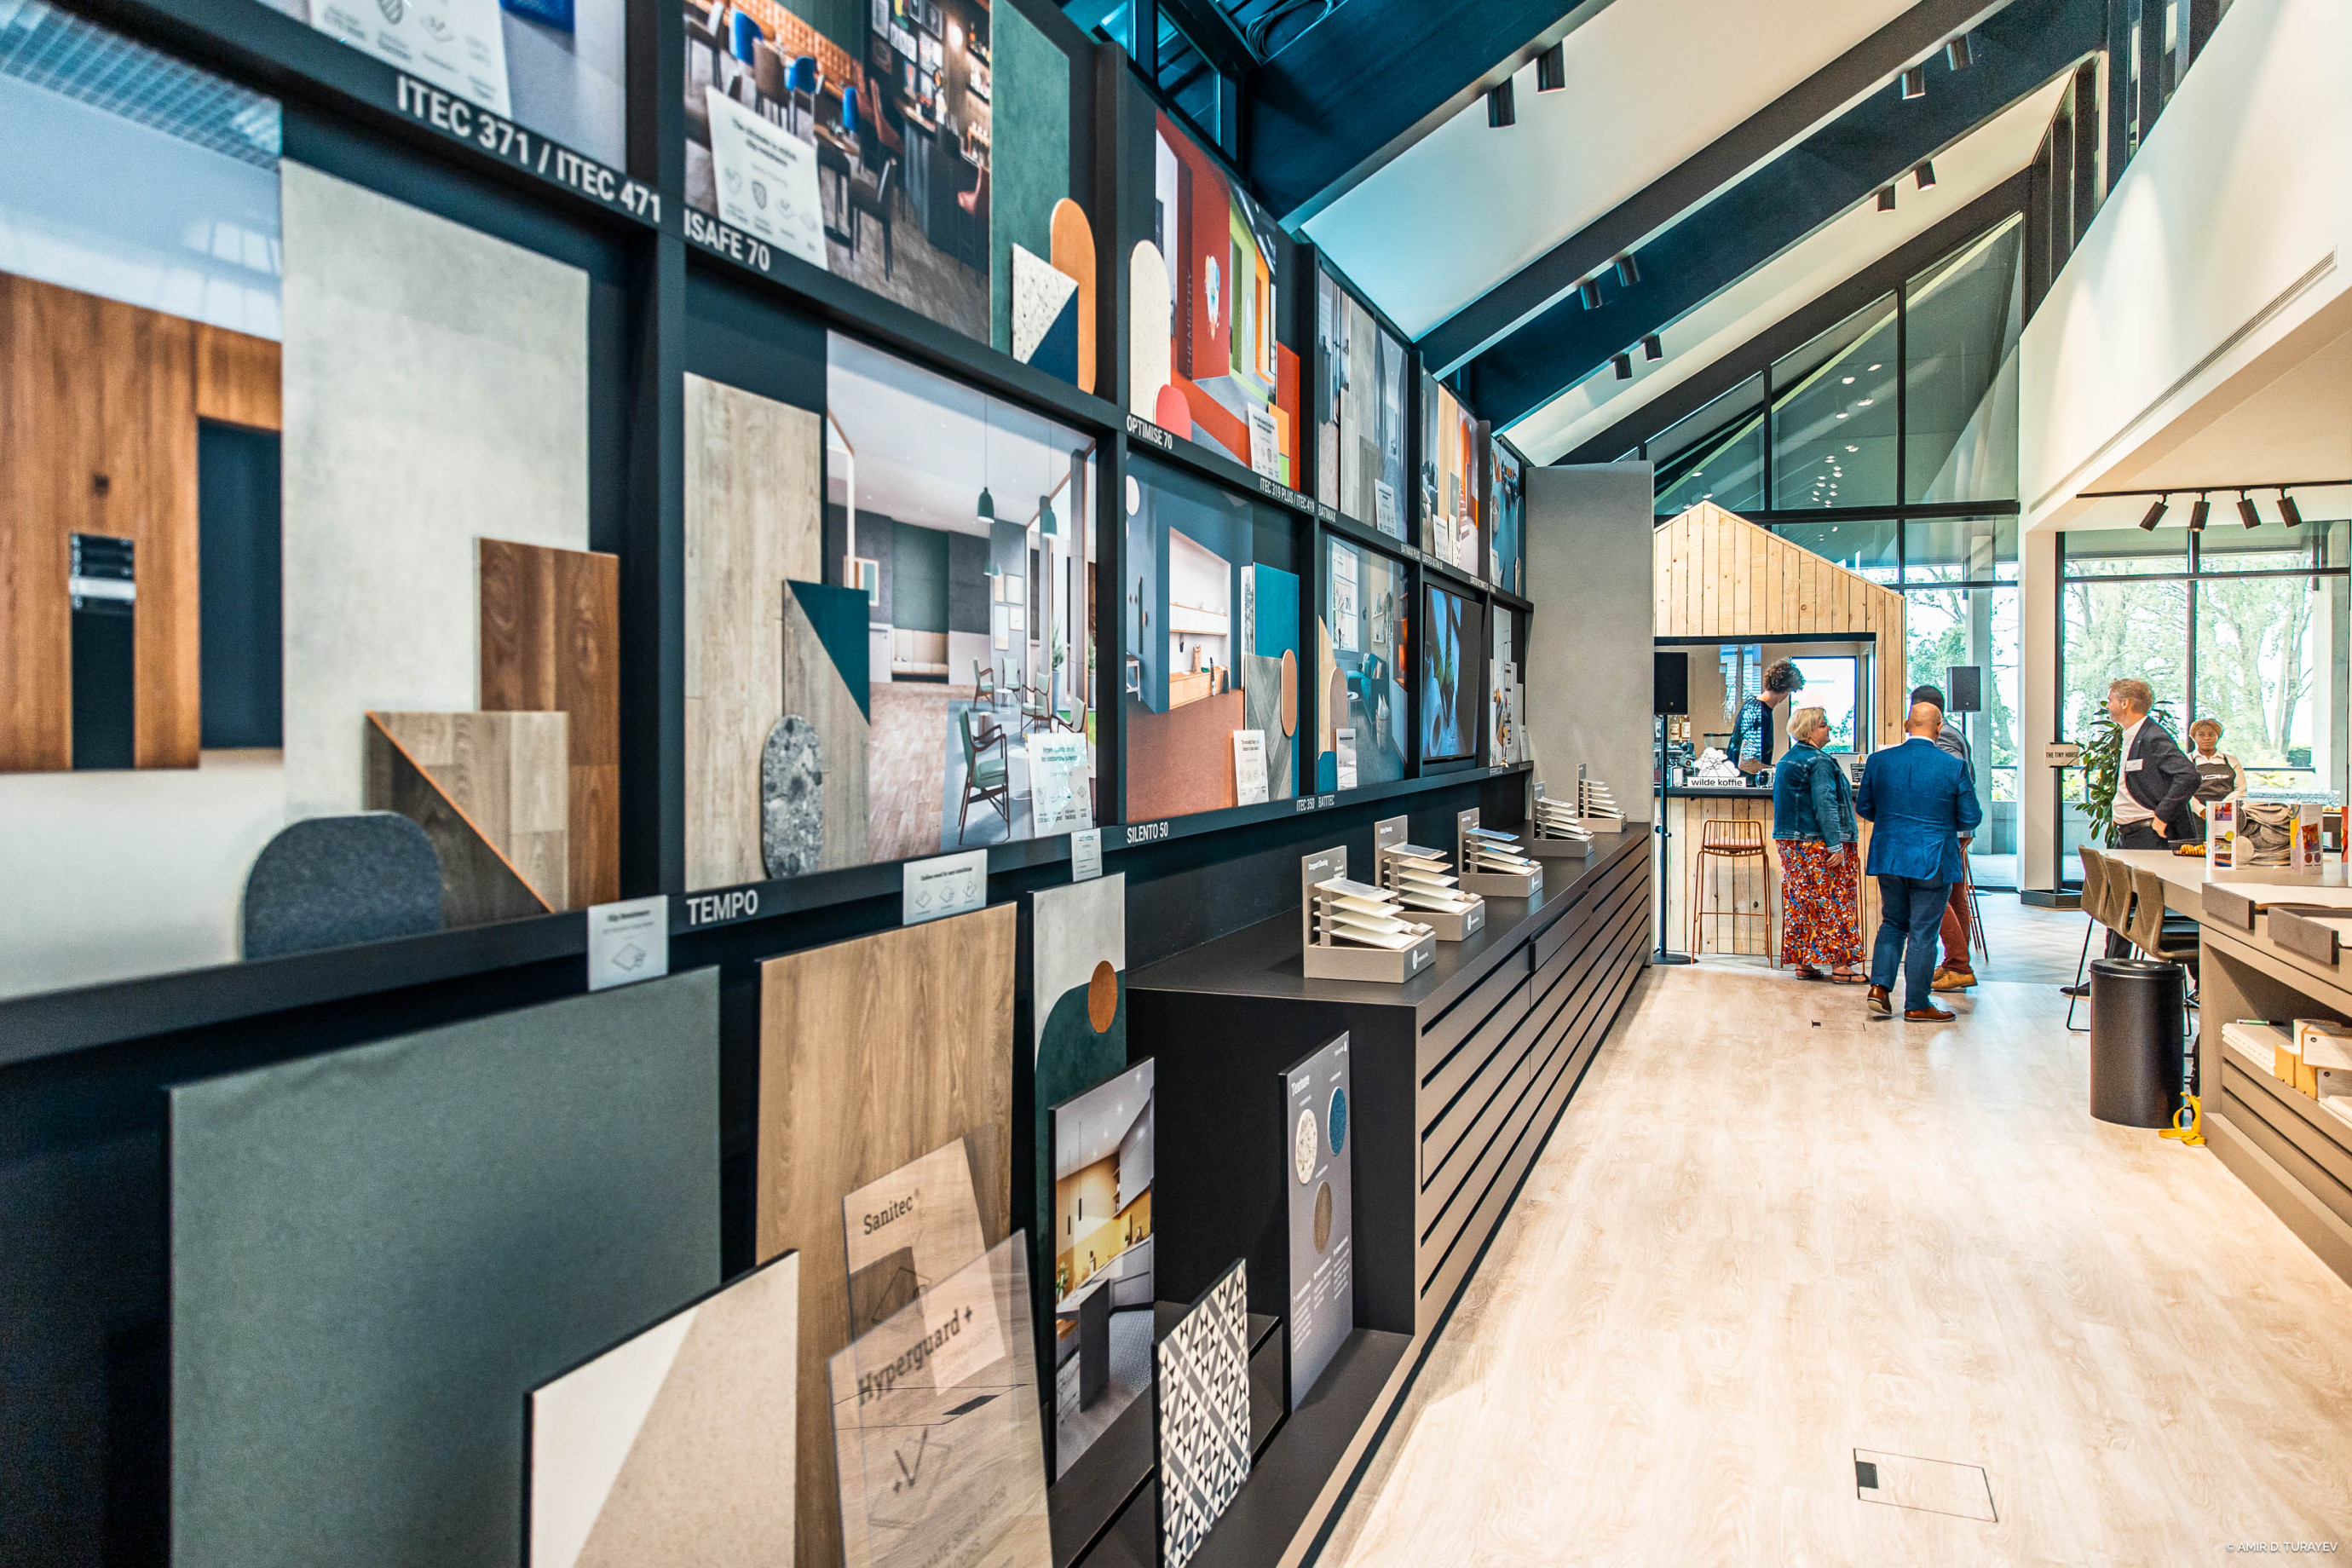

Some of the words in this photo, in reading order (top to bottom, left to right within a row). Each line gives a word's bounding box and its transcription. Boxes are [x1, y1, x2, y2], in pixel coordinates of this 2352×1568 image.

[396, 75, 471, 137] ITEC
[477, 113, 528, 164] 371
[537, 143, 551, 174] /
[556, 150, 615, 201] ITEC
[620, 181, 661, 223] 471
[683, 210, 743, 261] ISAFE
[746, 238, 770, 272] 70
[1127, 414, 1162, 446] OPTIMISE
[1163, 431, 1173, 450] 70
[1260, 478, 1271, 494] ITEC
[1271, 483, 1281, 499] 319
[1281, 487, 1294, 505] PLUS
[1296, 494, 1307, 510] ITEC
[1691, 778, 1715, 787] wilde
[1717, 778, 1743, 787] koffie
[1296, 798, 1306, 812] ITEC
[1306, 797, 1315, 810] 350
[1317, 794, 1335, 808] BATITEC
[1127, 823, 1158, 844] SILENTO
[1159, 821, 1168, 838] 50
[685, 890, 758, 926] TEMPO
[863, 1196, 913, 1236] Sanitec
[858, 1307, 960, 1406] Hyperguard
